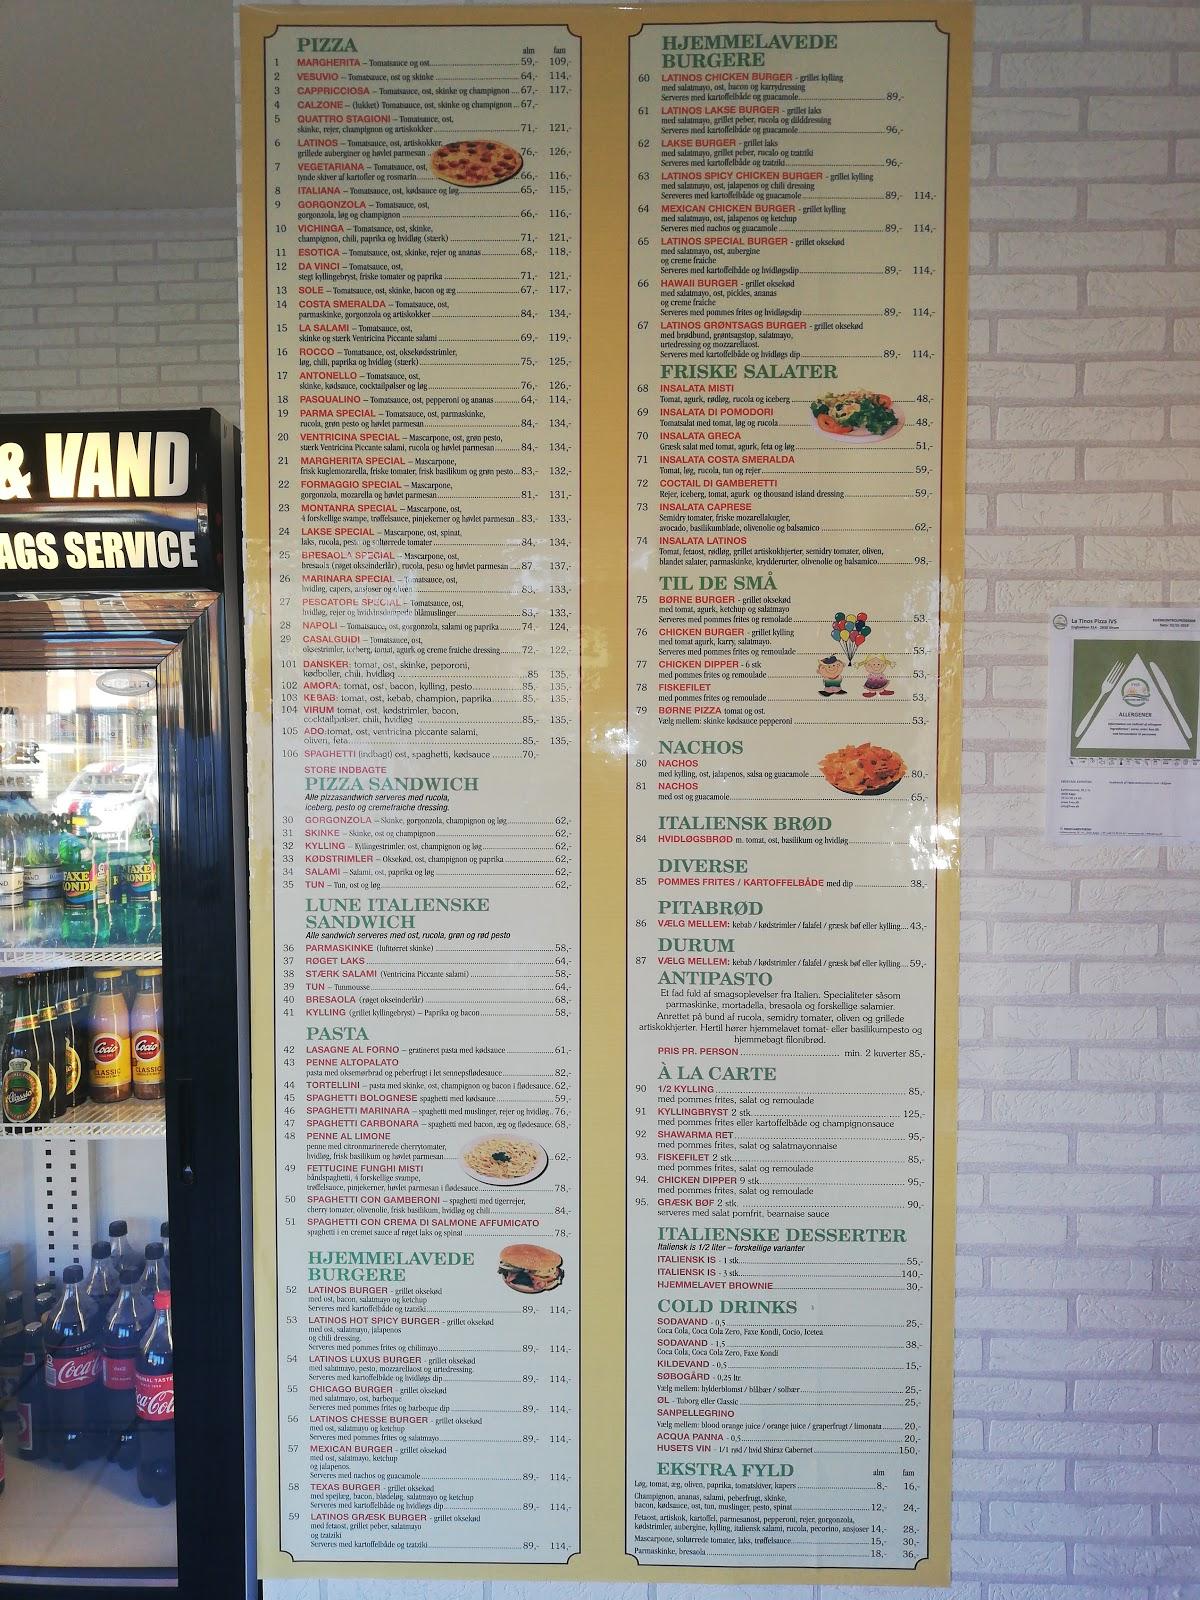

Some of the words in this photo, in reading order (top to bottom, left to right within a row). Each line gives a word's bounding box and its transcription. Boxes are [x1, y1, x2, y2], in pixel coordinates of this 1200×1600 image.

[296, 38, 358, 52] PIZZA
[662, 34, 837, 50] HJEMMELAVEDE
[554, 46, 566, 54] fam
[274, 58, 278, 66] 1
[297, 58, 361, 67] MARGHERITA
[367, 59, 408, 68] Tomatsauce
[409, 61, 418, 69] og
[521, 57, 538, 67] 59,-
[550, 57, 571, 67] 109,-
[662, 52, 765, 68] BURGERE
[297, 73, 339, 81] VESUVIO
[638, 74, 650, 82] 60
[662, 74, 703, 82] LATINOS
[705, 73, 749, 82] CHICKEN
[752, 73, 793, 83] BURGER
[296, 87, 370, 95] CAPPRICCIOSA
[297, 115, 343, 123] QUATTRO
[346, 115, 390, 123] STAGIONI
[298, 162, 365, 171] VEGETARIANA
[885, 224, 902, 233] 89,-
[914, 224, 936, 233] 114,-
[698, 279, 738, 287] BURGER
[299, 286, 324, 294] SOLE
[521, 286, 538, 295] 67,-
[549, 285, 571, 295] 117,-
[661, 321, 701, 329] LATINOS
[704, 321, 763, 331] GRØNTSAGS
[766, 322, 807, 330] BURGER
[660, 364, 737, 379] FRISKE
[744, 364, 838, 378] SALATER
[708, 384, 734, 392] MISTI
[300, 433, 357, 441] VENTRICINA
[360, 433, 400, 441] SPECIAL
[0, 443, 31, 499] &
[45, 432, 190, 498] VAND
[915, 522, 932, 533] 62,-
[64, 531, 198, 569] SERVICE
[659, 576, 693, 590] TIL
[699, 576, 727, 590] DE
[734, 571, 778, 590] SMÅ
[344, 682, 370, 691] tomat,
[373, 683, 387, 691] ost,
[390, 682, 416, 690] bacon,
[420, 682, 447, 691] kylling,
[451, 683, 472, 692] pesto
[658, 741, 743, 754] NACHOS
[305, 777, 365, 793] PIZZA
[369, 777, 479, 791] SANDWICH
[658, 816, 768, 830] ITALIENSK
[773, 817, 832, 830] BRØD
[659, 835, 733, 843] HVIDLØGSBRØD
[555, 842, 572, 851] 62,-
[658, 859, 747, 873] DIVERSE
[63, 881, 95, 892] ONDI
[703, 878, 735, 886] FRITES
[306, 898, 361, 912] LUNE
[368, 898, 489, 911] ITALIENSKE
[658, 901, 763, 915] PITABRØD
[306, 915, 415, 931] SANDWICH
[491, 932, 510, 940] pesto
[555, 944, 571, 954] 58,-
[658, 938, 735, 952] DURUM
[555, 957, 571, 967] 64,-
[657, 971, 772, 986] ANTIPASTO
[672, 989, 684, 997] fad
[687, 989, 701, 997] fuld
[704, 989, 711, 997] af
[714, 991, 778, 999] smagsoplevelser
[781, 990, 792, 998] fra
[824, 991, 873, 1000] Specialiteter
[306, 1027, 369, 1040] PASTA
[95, 1041, 119, 1054] Cocio
[136, 1040, 158, 1051] Cocio
[555, 1046, 571, 1055] 61,-
[657, 1062, 672, 1079] À
[677, 1066, 704, 1080] LA
[709, 1067, 776, 1080] CARTE
[658, 1108, 728, 1116] KYLLINGBRYST
[904, 1110, 925, 1118] 125,-
[908, 1178, 925, 1187] 95,-
[658, 1227, 779, 1244] ITALIENSKE
[786, 1229, 907, 1242] DESSERTER
[308, 1252, 474, 1265] HJEMMELAVEDE
[308, 1268, 405, 1281] BURGERE
[658, 1299, 713, 1313] COLD
[720, 1301, 797, 1314] DRINKS
[906, 1362, 922, 1370] 15,-
[657, 1409, 734, 1417] SANPELLEGRINO
[657, 1462, 737, 1476] EKSTRA
[742, 1464, 794, 1477] FYLD
[523, 1542, 539, 1550] 89,-
[551, 1542, 572, 1551] 114,-
[872, 1549, 886, 1559] 18,-
[903, 1550, 919, 1561] 36,-
